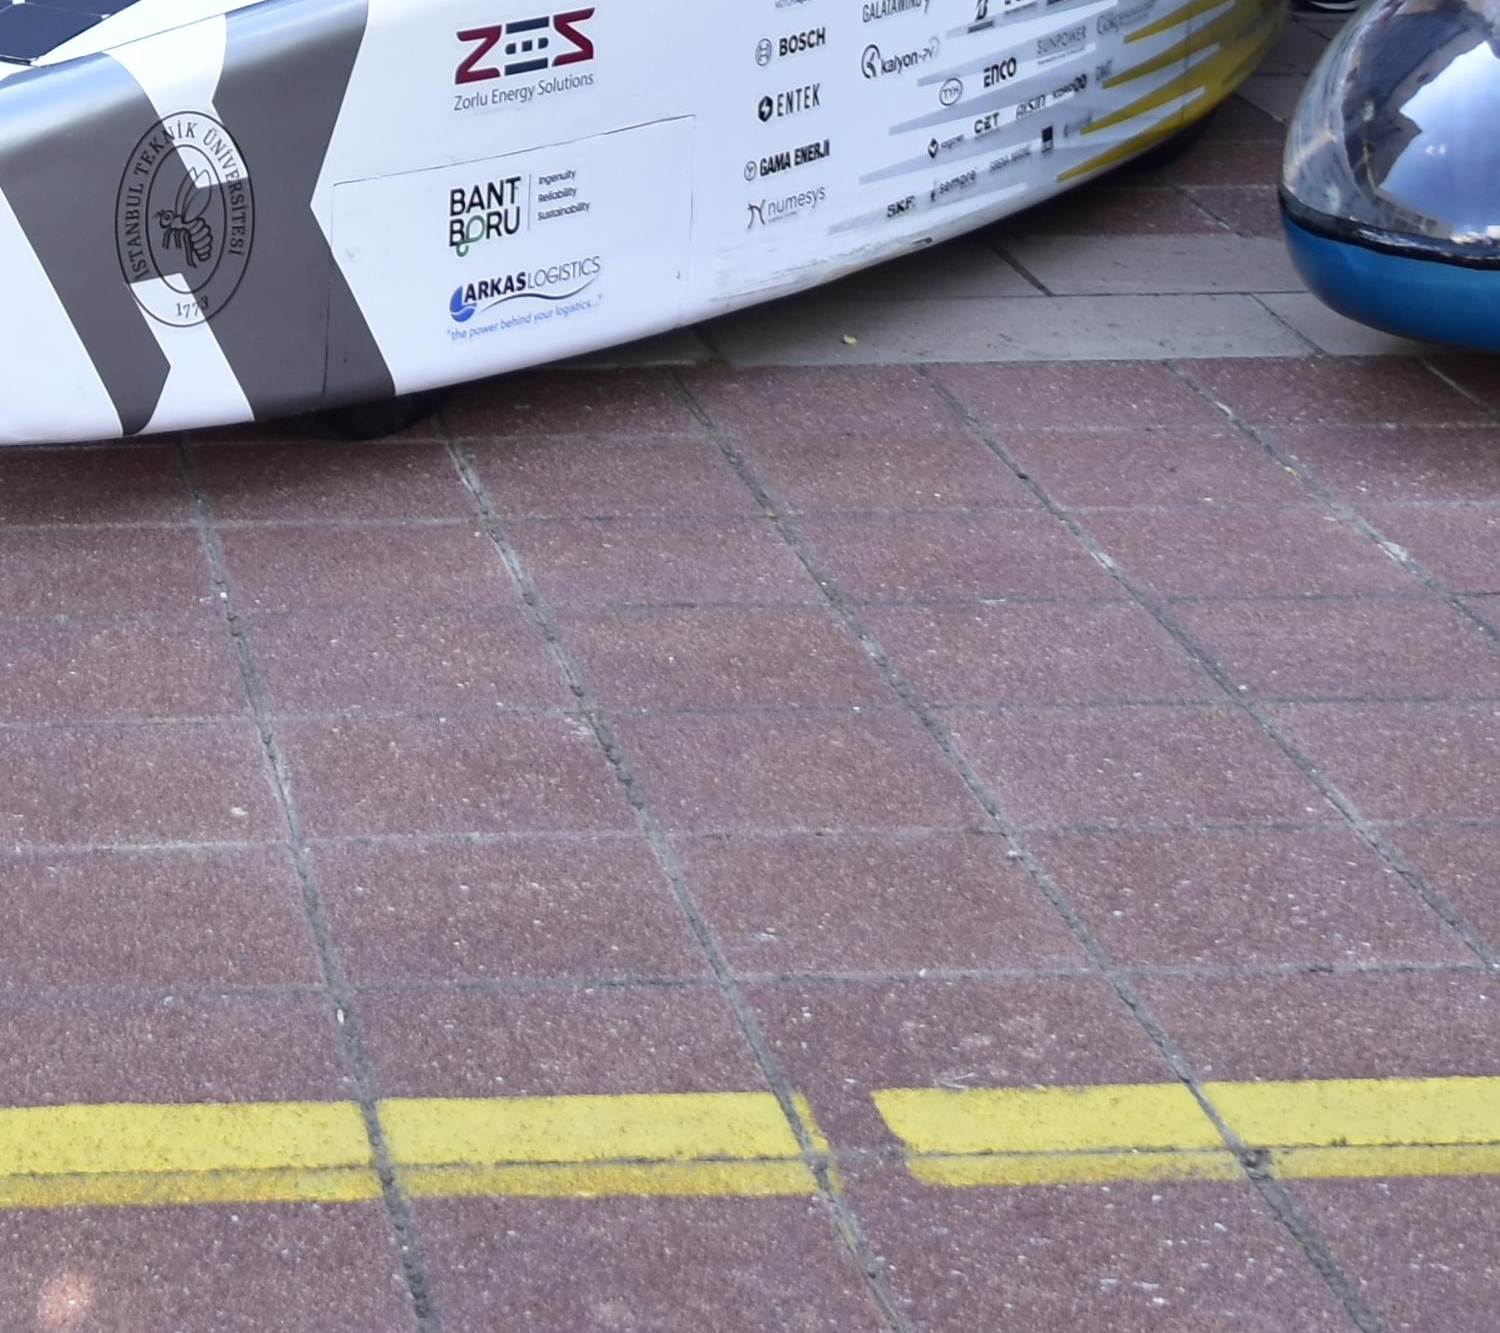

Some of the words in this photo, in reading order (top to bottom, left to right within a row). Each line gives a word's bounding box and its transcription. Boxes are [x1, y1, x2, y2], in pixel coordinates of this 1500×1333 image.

[454, 7, 596, 85] ZES
[778, 27, 826, 57] BOSCH
[453, 91, 488, 111] Zorlu
[491, 84, 535, 104] Energy
[537, 73, 594, 96] Solutions
[777, 83, 821, 117] ENTEK
[760, 152, 792, 177] GAMA
[450, 176, 522, 217] BANT
[538, 187, 577, 203] Reliability
[768, 185, 826, 216] numesys
[887, 194, 915, 219] SKF
[537, 201, 591, 221] Sustainability
[449, 206, 521, 257] BORU
[175, 295, 209, 318] 1773
[469, 322, 499, 339] power
[501, 314, 532, 330] behind
[533, 310, 553, 324] your
